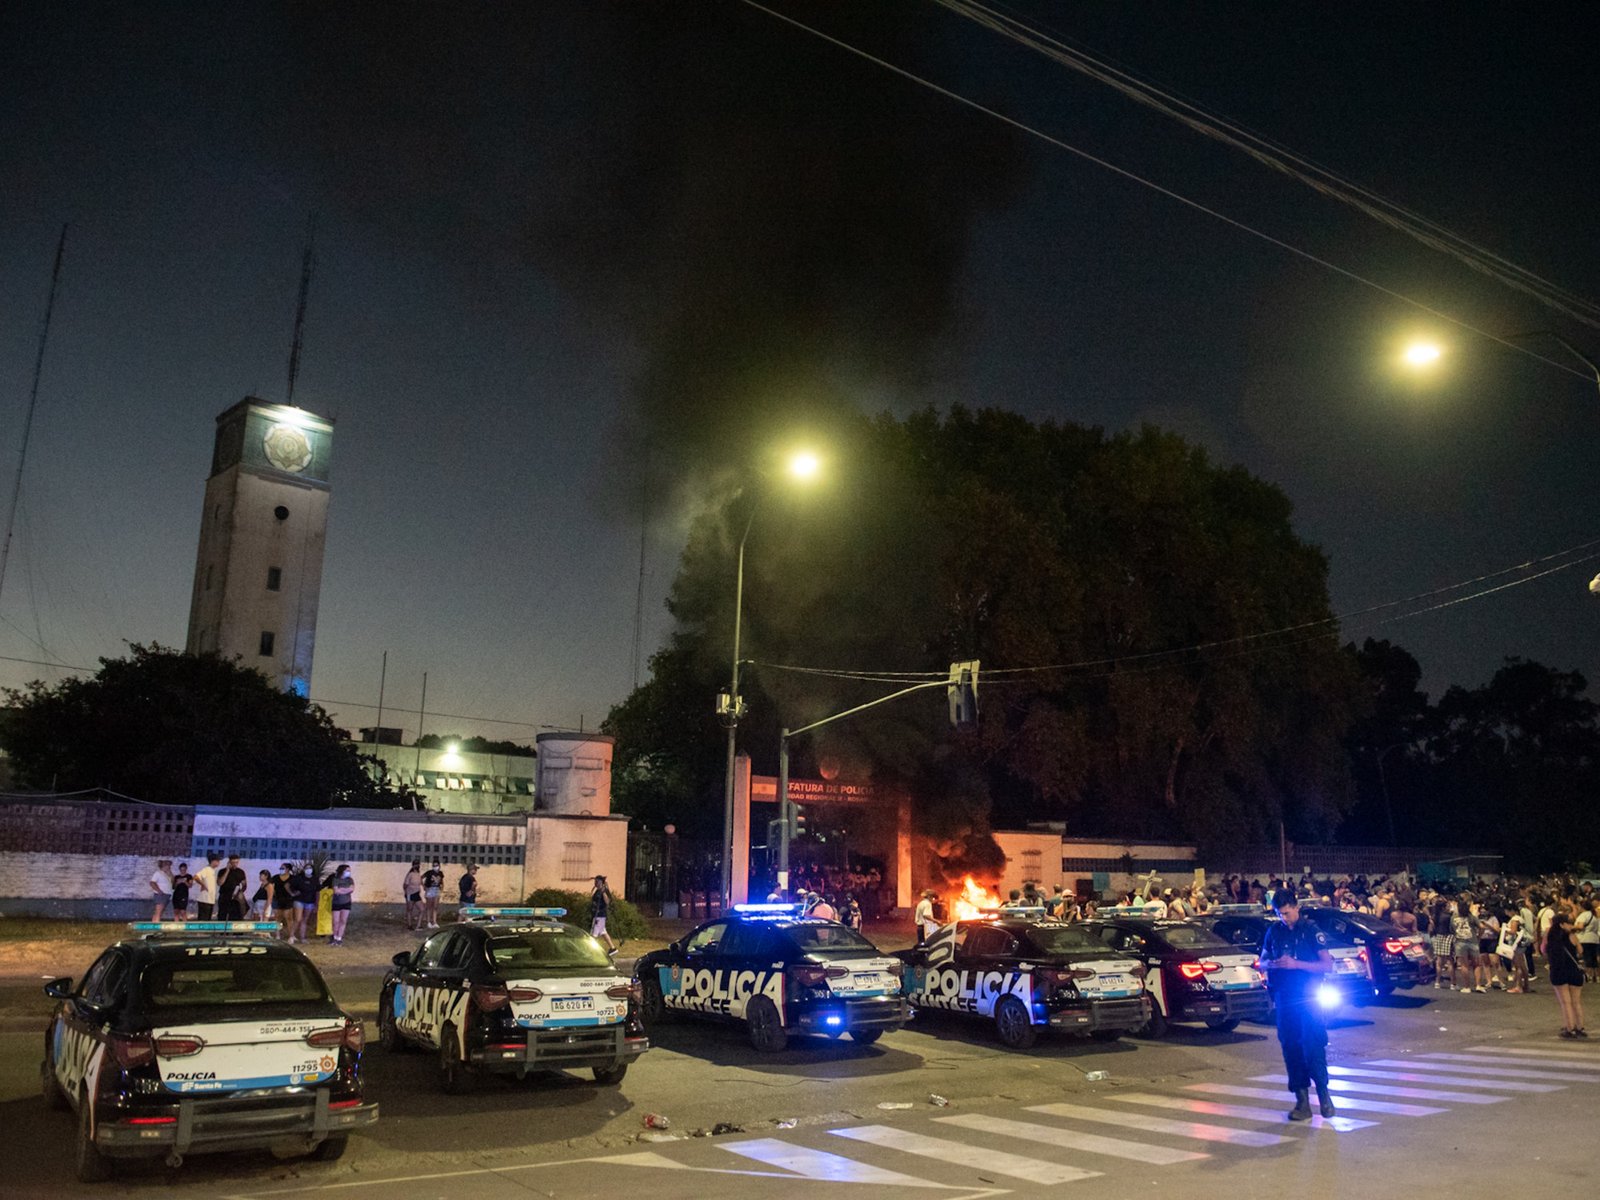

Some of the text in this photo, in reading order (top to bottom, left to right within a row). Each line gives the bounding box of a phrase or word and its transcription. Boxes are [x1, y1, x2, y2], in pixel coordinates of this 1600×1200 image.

[826, 784, 839, 793] DE
[185, 947, 268, 956] 11295
[681, 968, 784, 1025] POLICIA
[925, 969, 1034, 1023] POLICIA
[406, 985, 470, 1052] POLICIA
[291, 1064, 319, 1073] 11295
[166, 1072, 216, 1081] POLICIA
